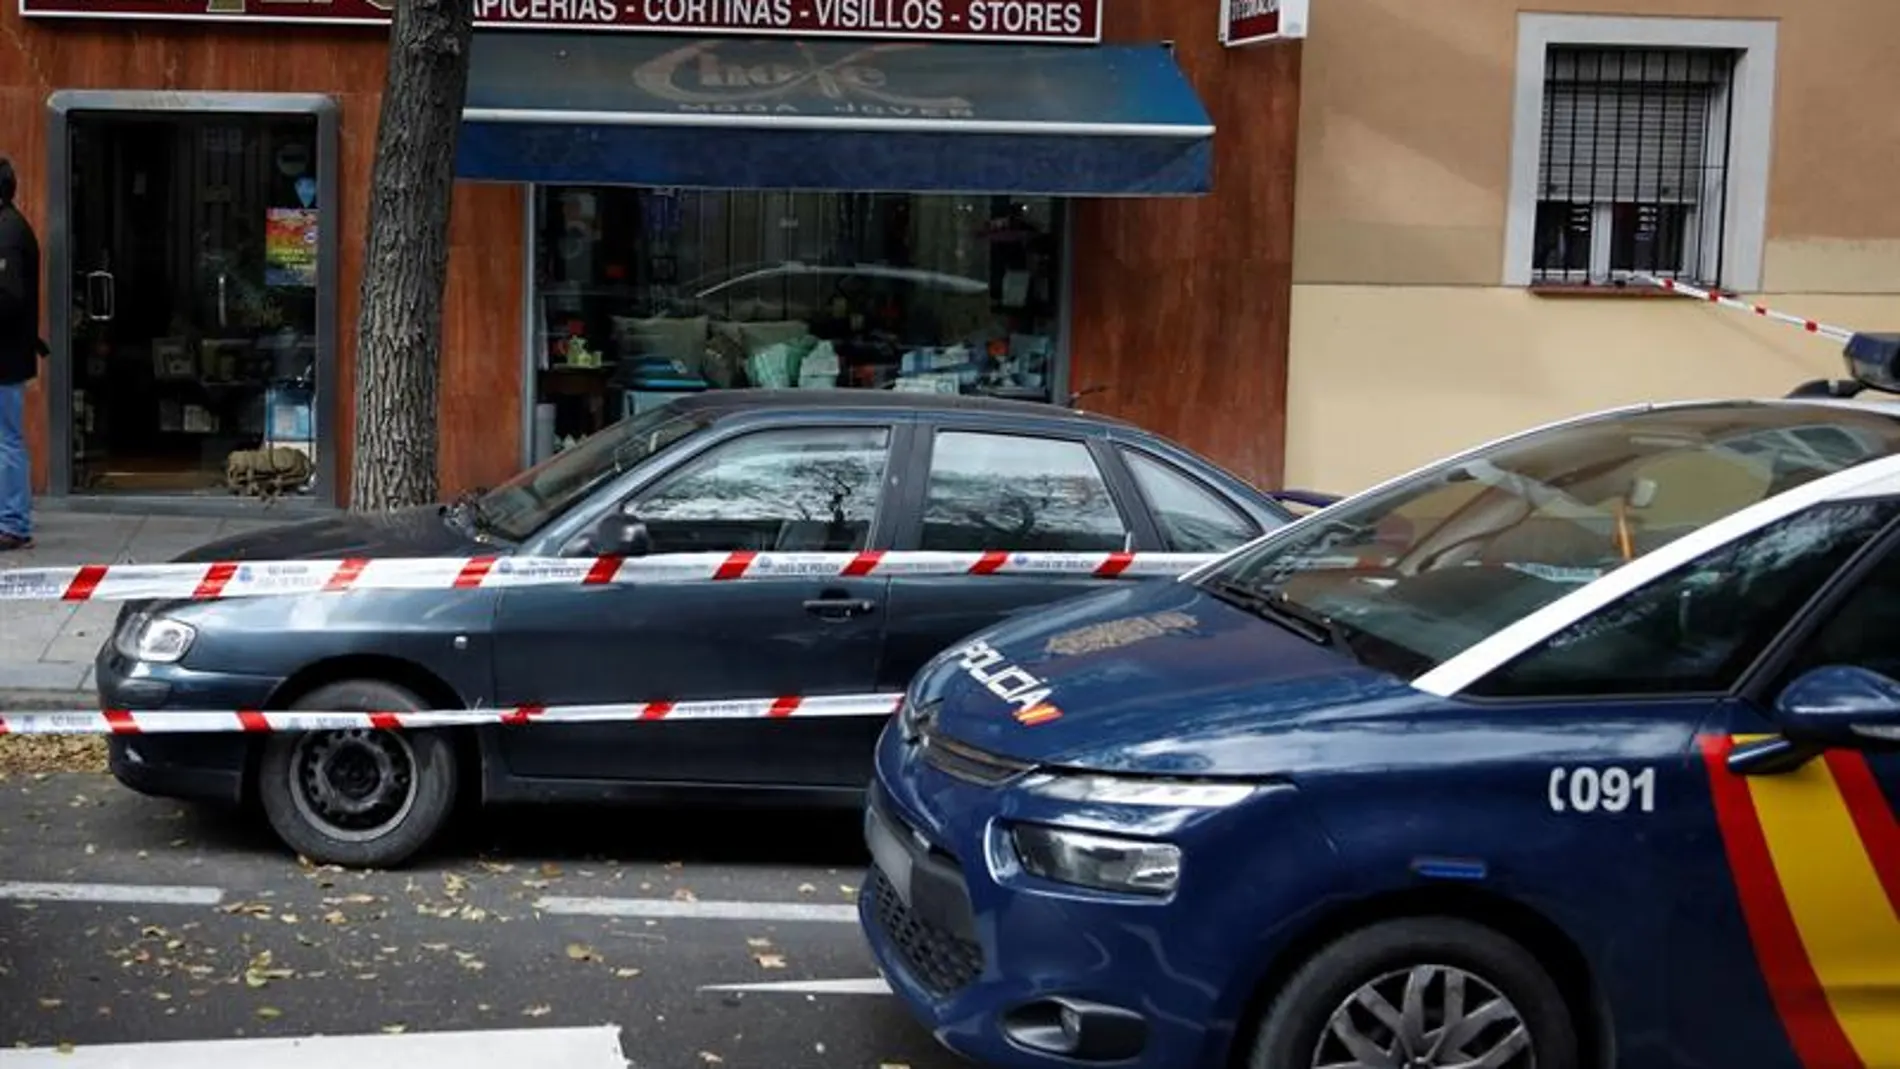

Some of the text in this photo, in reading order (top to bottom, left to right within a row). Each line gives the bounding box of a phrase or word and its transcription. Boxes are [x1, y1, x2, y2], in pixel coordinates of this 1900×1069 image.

[643, 0, 791, 25] CORTINAS
[816, 0, 943, 29] VISILLOS
[968, 1, 1082, 33] STORES
[1569, 766, 1655, 812] 091
